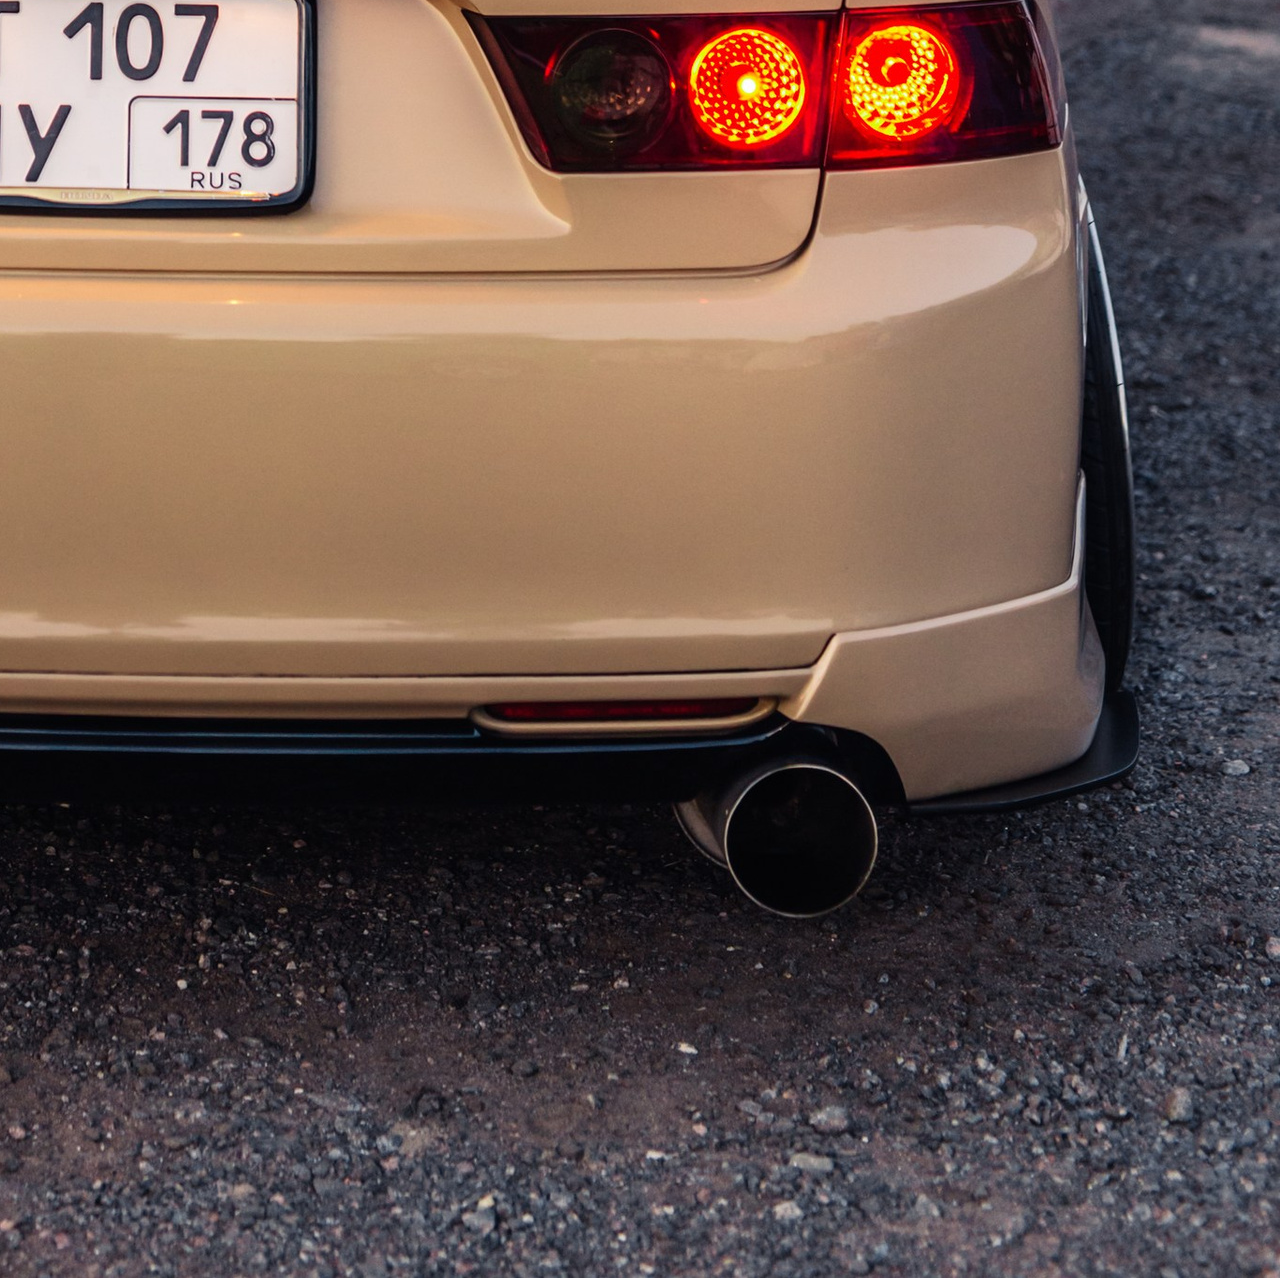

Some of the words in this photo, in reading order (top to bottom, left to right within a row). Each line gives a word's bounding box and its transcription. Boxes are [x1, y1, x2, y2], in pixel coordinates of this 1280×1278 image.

[62, 1, 220, 83] 107
[161, 109, 277, 169] 178
[190, 171, 244, 191] RUS
